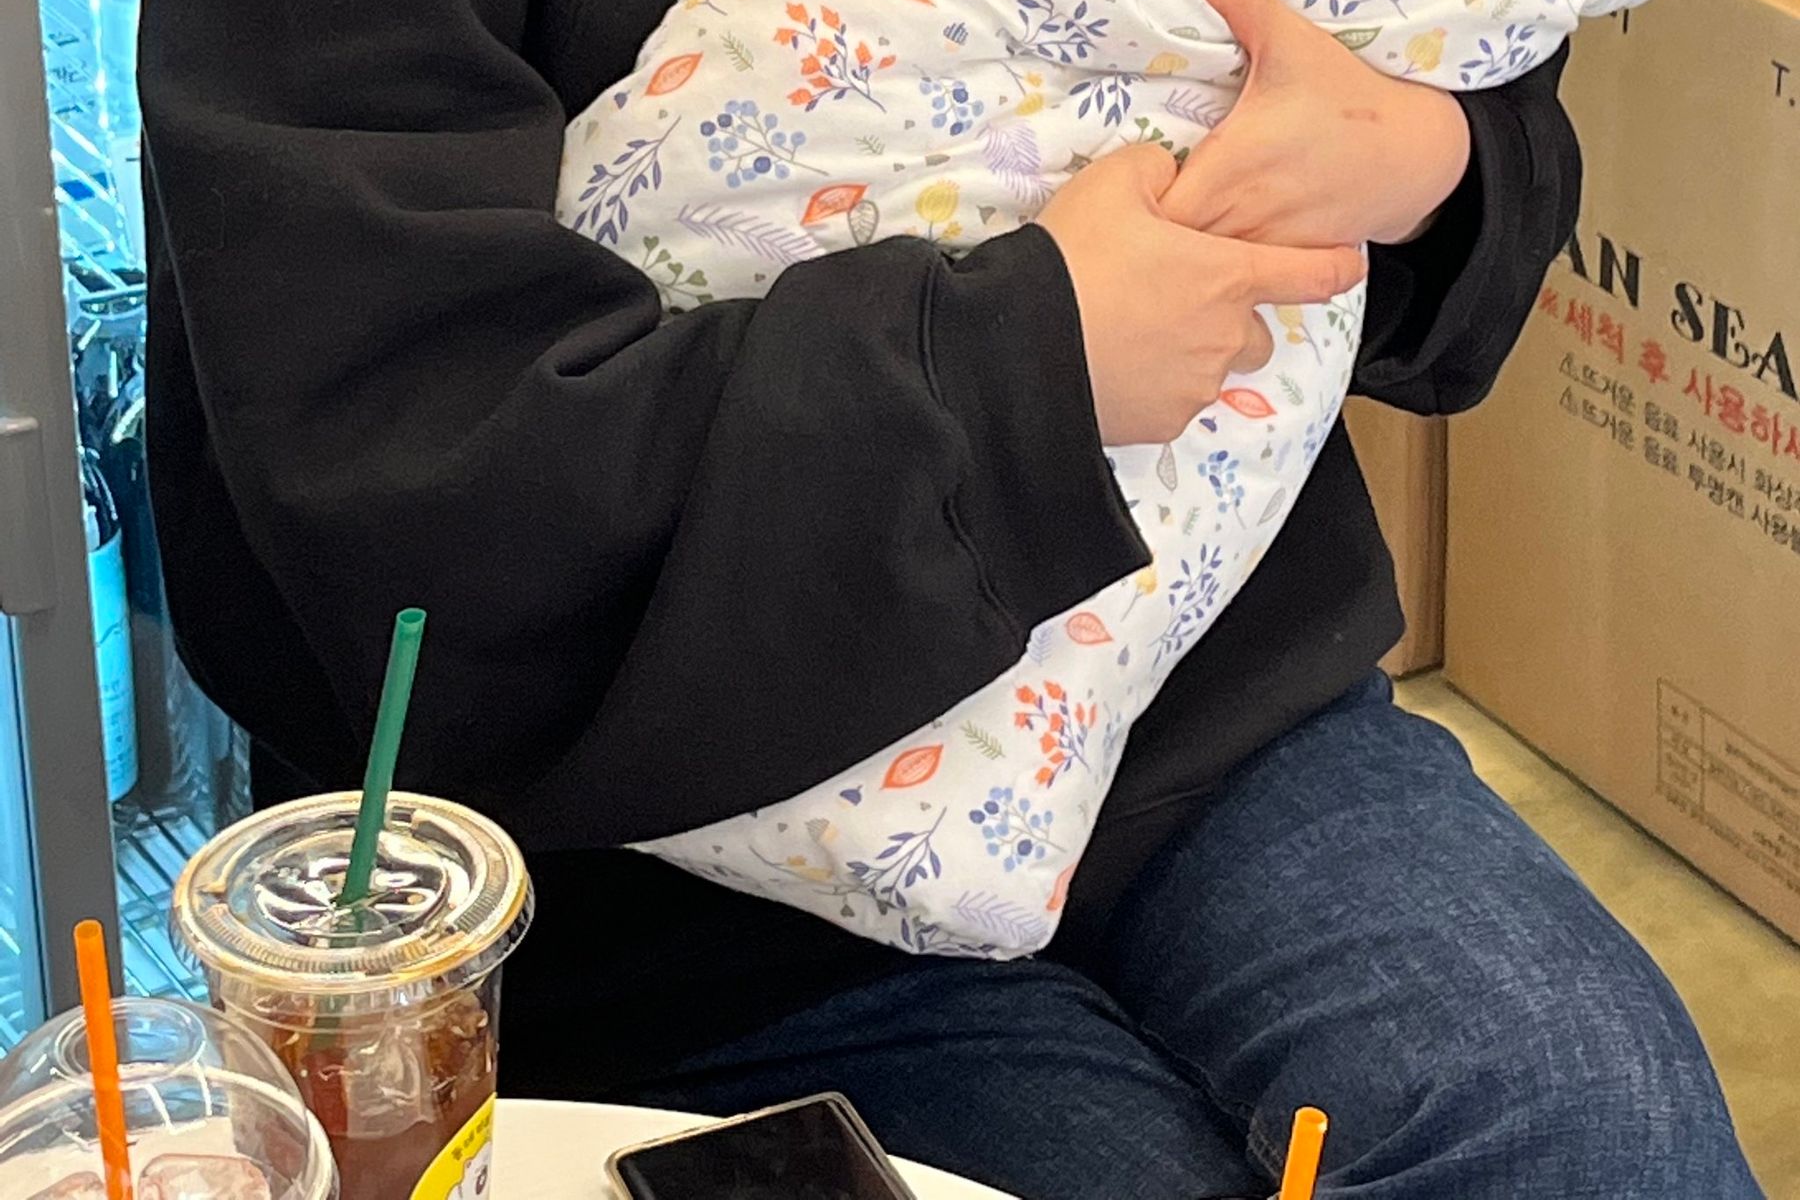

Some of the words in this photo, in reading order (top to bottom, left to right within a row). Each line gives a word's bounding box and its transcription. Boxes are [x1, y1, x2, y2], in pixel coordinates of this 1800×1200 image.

[1638, 339, 1669, 383] 후
[1582, 364, 1635, 417] 뜨거운
[1644, 401, 1680, 442] 음료
[1688, 429, 1746, 485] 사용시
[1582, 399, 1636, 451] 뜨거운
[1643, 436, 1681, 477] 음료
